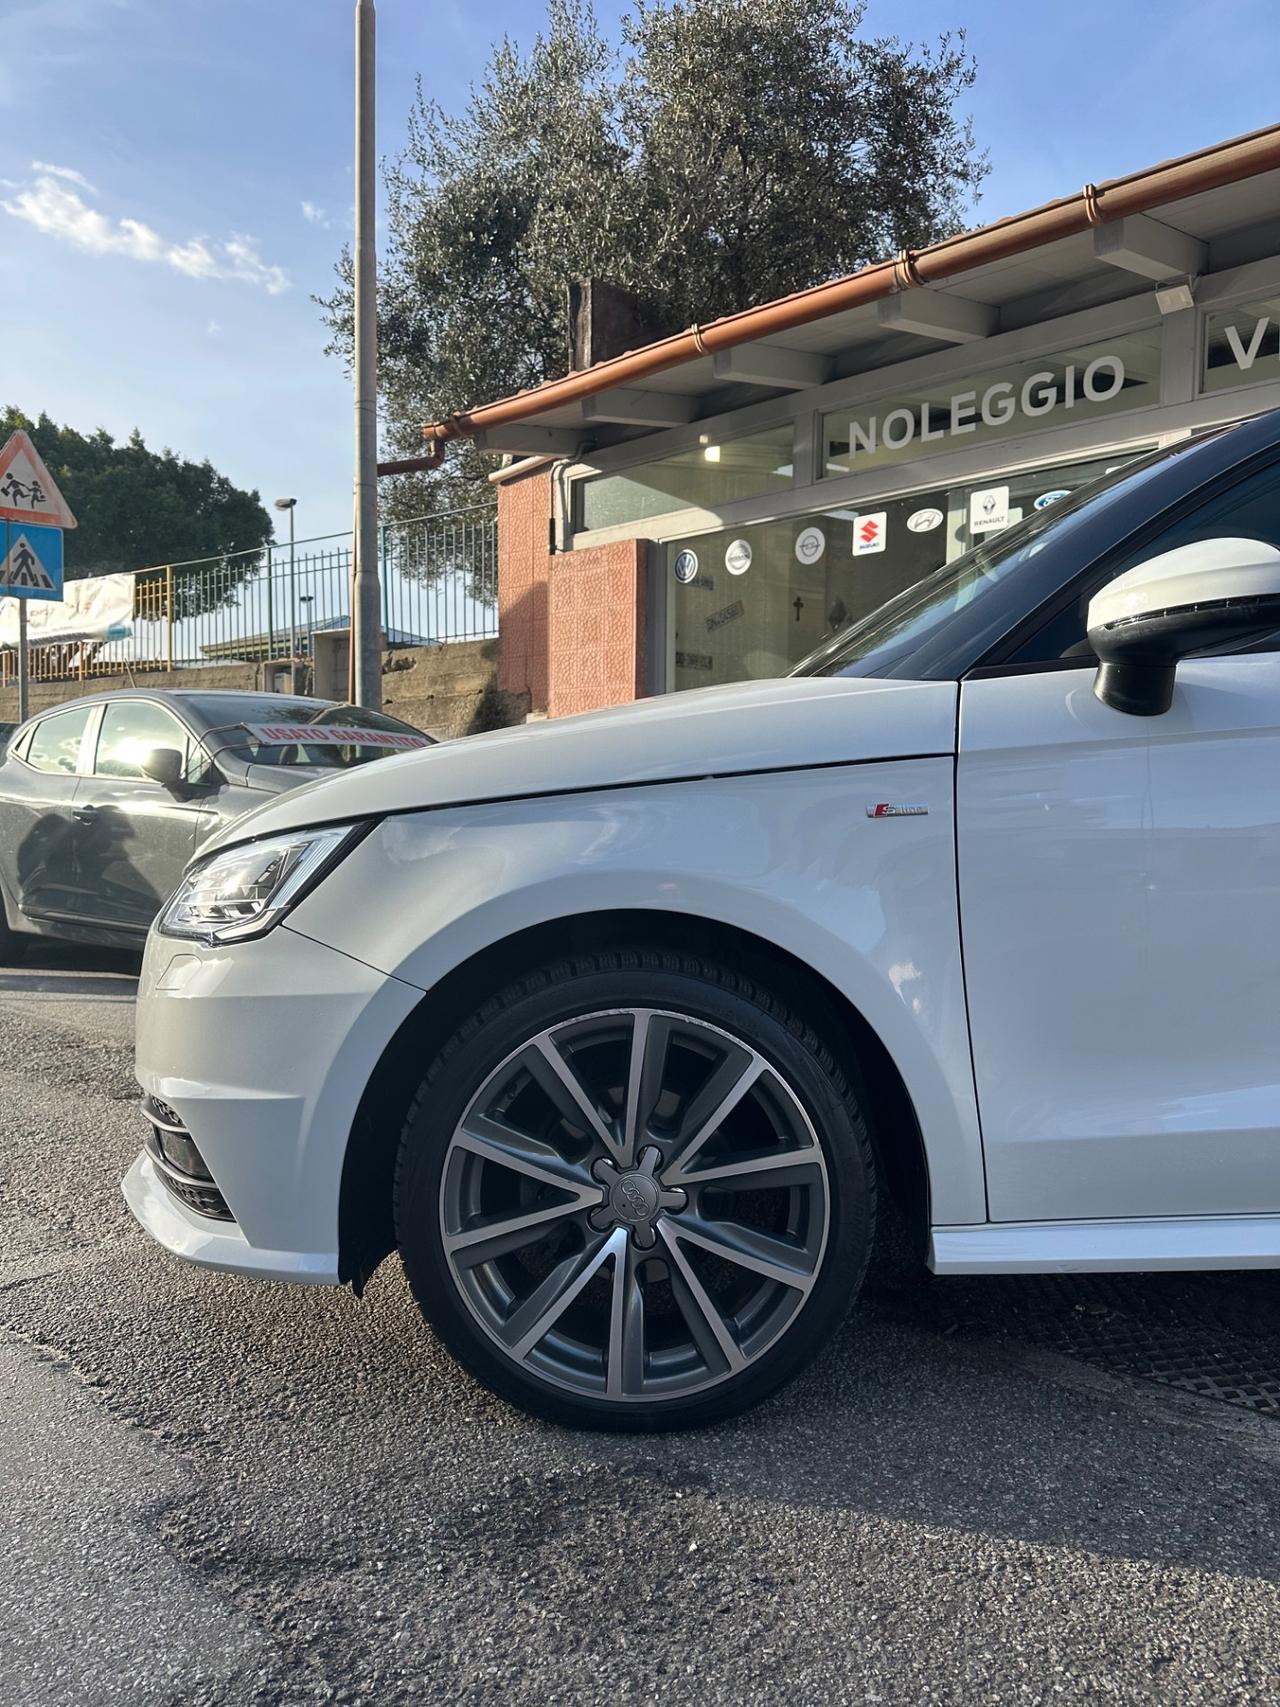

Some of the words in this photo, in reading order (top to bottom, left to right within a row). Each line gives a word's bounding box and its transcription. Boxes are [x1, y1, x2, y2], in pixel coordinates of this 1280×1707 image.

[849, 355, 1125, 459] NOLEGGIO
[1224, 317, 1280, 370] V
[974, 516, 1005, 526] RENAULT
[260, 728, 329, 741] USATO
[329, 729, 427, 748] GARANTITO
